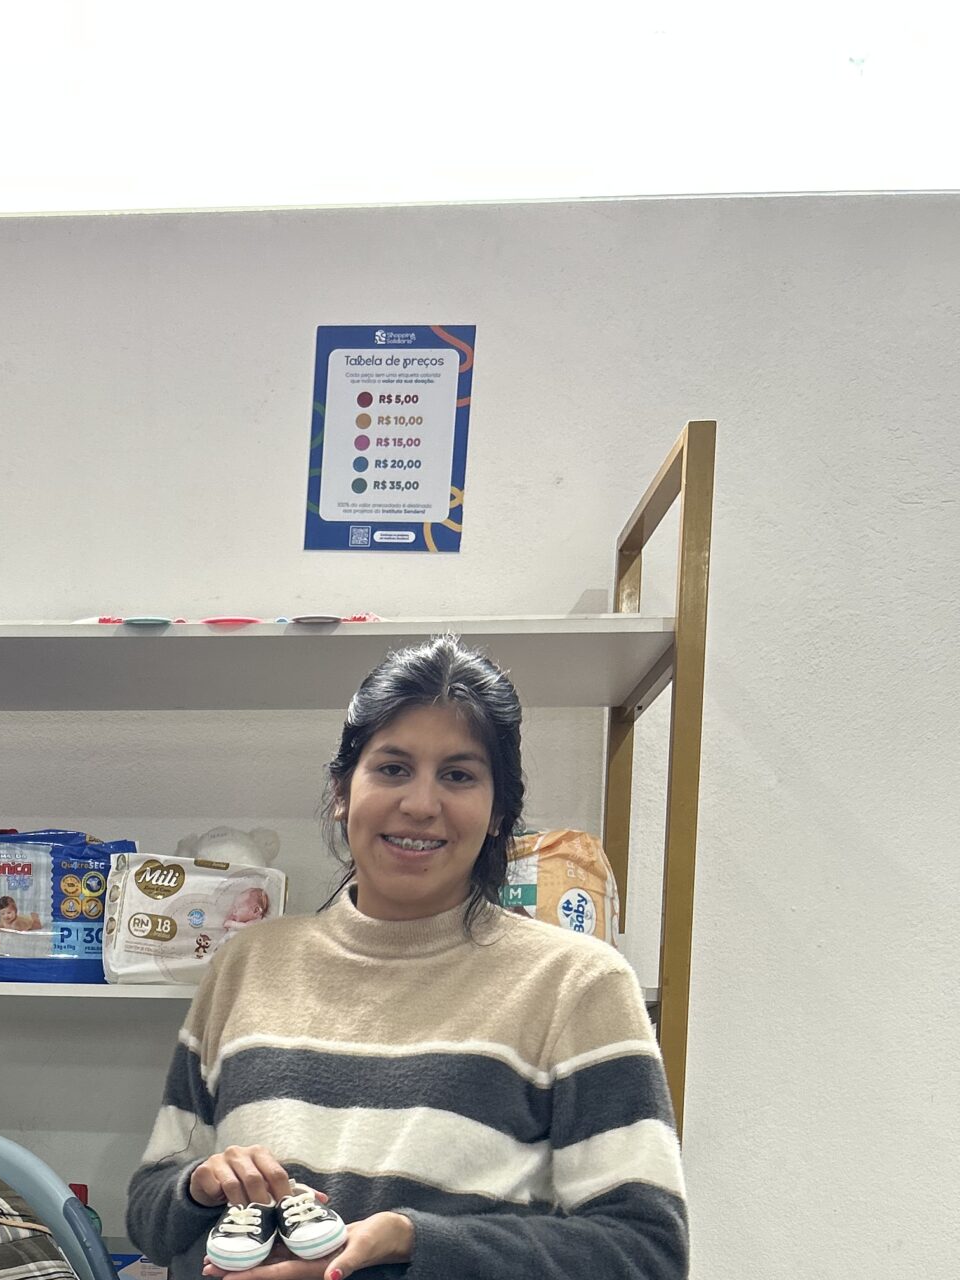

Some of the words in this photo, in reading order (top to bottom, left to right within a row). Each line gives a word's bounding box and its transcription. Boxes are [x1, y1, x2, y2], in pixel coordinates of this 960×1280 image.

[344, 355, 382, 366] Tabela
[385, 355, 400, 366] de
[402, 357, 445, 369] preços
[379, 394, 393, 405] R$
[395, 394, 419, 405] 5,00
[377, 415, 391, 426] R$
[393, 416, 423, 427] 10,00
[376, 437, 390, 447] R$
[392, 438, 421, 448] 15,00
[374, 459, 388, 469] R$
[390, 460, 422, 470] 20,00
[373, 480, 387, 490] R$
[389, 481, 420, 491] 35,00
[138, 867, 179, 887] Mili
[509, 887, 522, 900] M
[573, 893, 588, 933] Baby
[132, 917, 149, 928] RN
[156, 919, 171, 933] 18
[60, 927, 72, 943] P
[83, 927, 103, 944] 30
